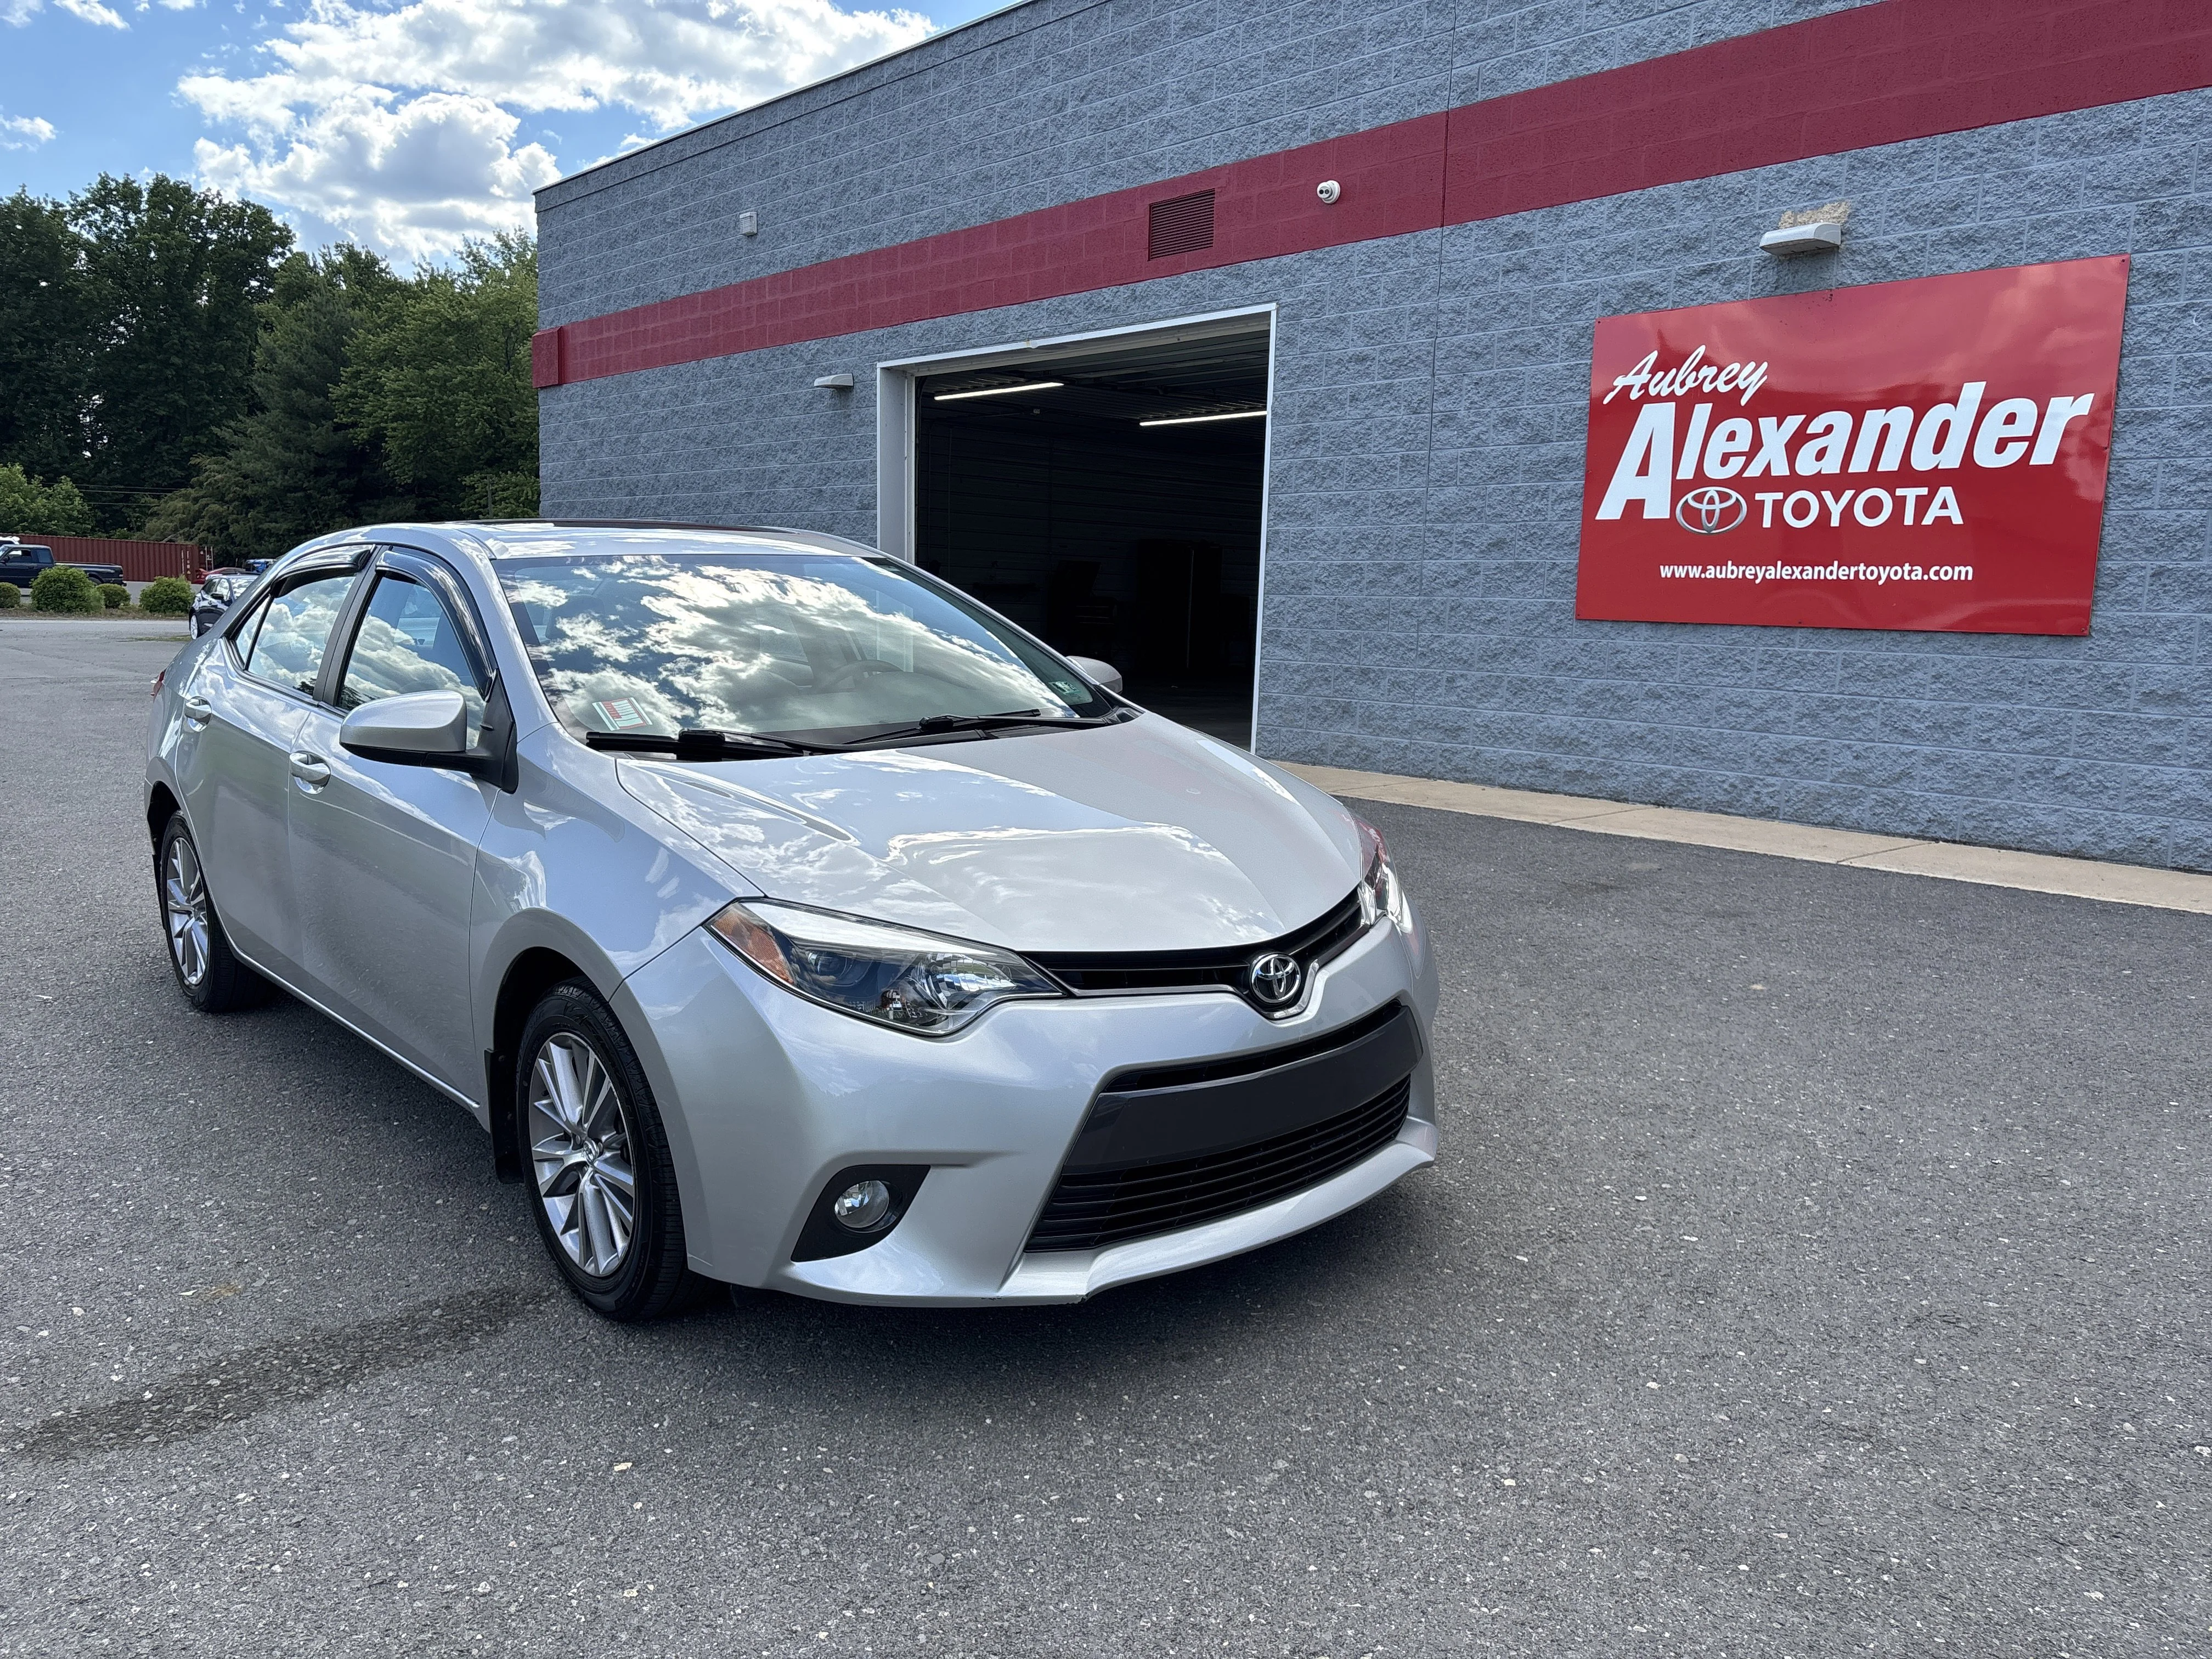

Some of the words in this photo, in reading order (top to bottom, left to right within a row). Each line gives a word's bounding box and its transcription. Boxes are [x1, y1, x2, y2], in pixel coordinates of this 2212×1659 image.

[1602, 345, 1769, 407] Aubrey
[1595, 381, 2096, 520] Alexander
[1754, 486, 1964, 528] TOYOTA
[1659, 560, 1973, 585] www.aubreyalexandertoyota.com
